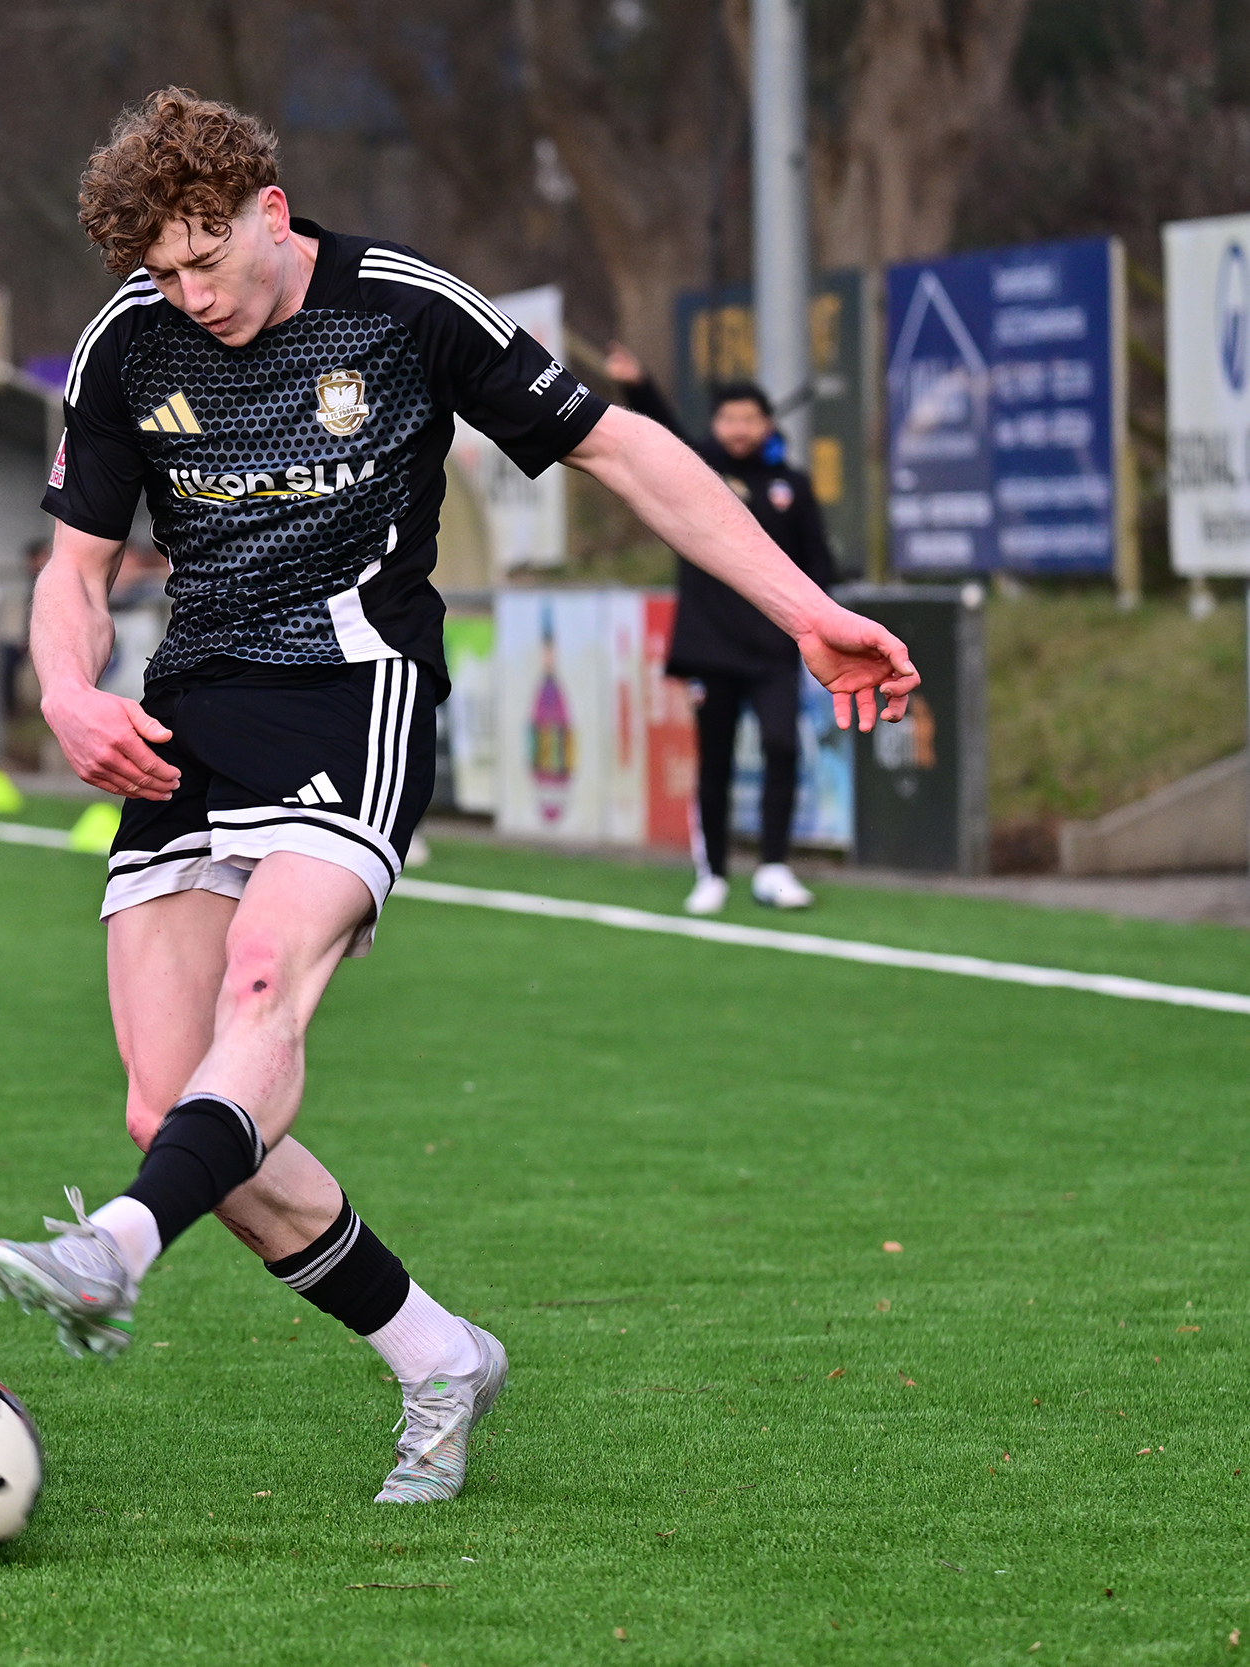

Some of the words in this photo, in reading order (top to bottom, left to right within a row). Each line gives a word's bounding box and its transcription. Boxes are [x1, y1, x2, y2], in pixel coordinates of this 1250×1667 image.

[528, 360, 564, 396] TÜVNO
[49, 470, 64, 486] ORD
[285, 460, 375, 494] SLM
